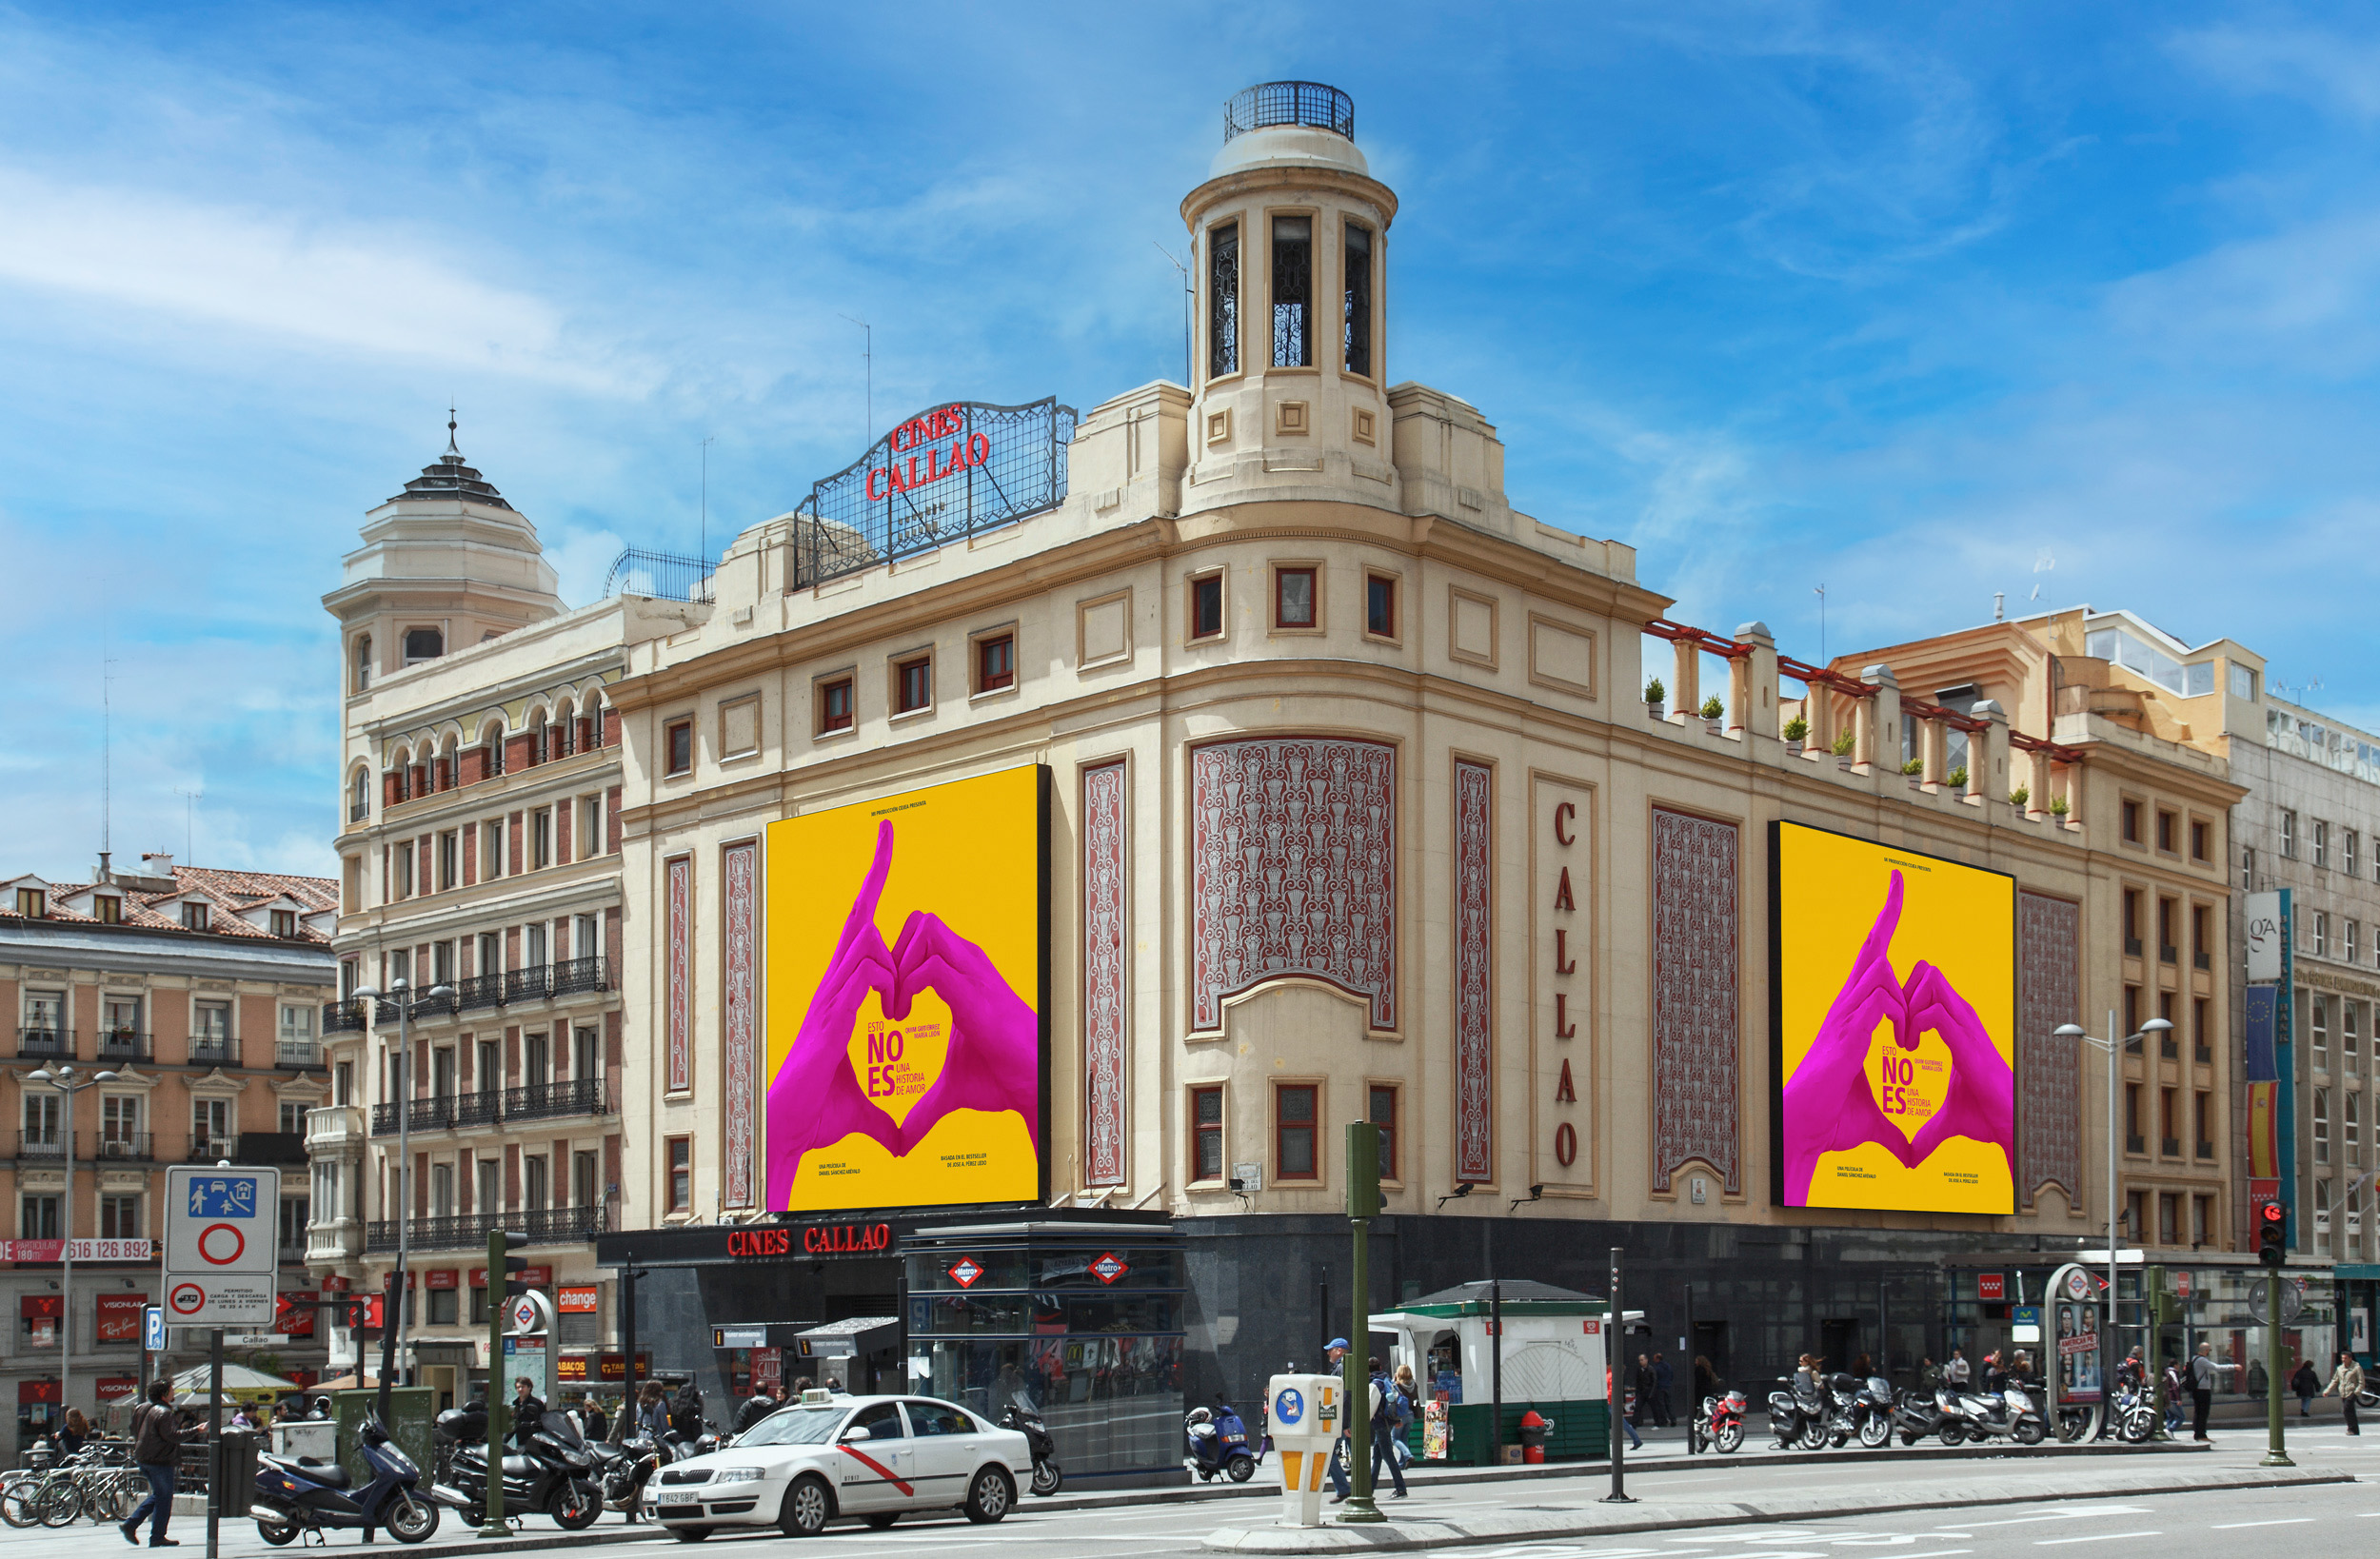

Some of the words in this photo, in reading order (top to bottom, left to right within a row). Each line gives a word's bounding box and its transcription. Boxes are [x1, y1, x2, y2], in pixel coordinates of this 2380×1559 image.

[891, 404, 962, 452] CINES
[866, 432, 990, 501] CALLAO
[1555, 801, 1577, 1167] CALLAO
[868, 1021, 883, 1033] ESTO
[2278, 1003, 2289, 1043] BANK
[868, 1030, 903, 1064] NO
[1883, 1046, 1896, 1056] ESTO
[897, 1063, 910, 1073] UNA
[1883, 1056, 1914, 1086] NO
[868, 1064, 895, 1097] ES
[897, 1073, 924, 1084] HISTORIA
[897, 1086, 904, 1095] DE
[905, 1084, 925, 1095] AMOR
[1907, 1088, 1919, 1096] UNA
[1883, 1086, 1906, 1115] ES
[1907, 1097, 1931, 1107] HISTORIA
[1908, 1107, 1914, 1115] DE
[1915, 1108, 1932, 1116] AMOR
[16, 1241, 57, 1250] PARTICULAR
[727, 1229, 791, 1256] CINES
[803, 1223, 891, 1253] CALLAO
[96, 1241, 118, 1258] 126
[124, 1241, 149, 1257] 892
[957, 1268, 975, 1276] Metro
[1099, 1264, 1118, 1273] Metro
[560, 1292, 596, 1309] change
[101, 1317, 137, 1336] Ray-Ban
[149, 1313, 160, 1346] P
[663, 1494, 678, 1504] 1642
[680, 1493, 693, 1502] GBF
[1664, 1530, 1973, 1546] BUS
